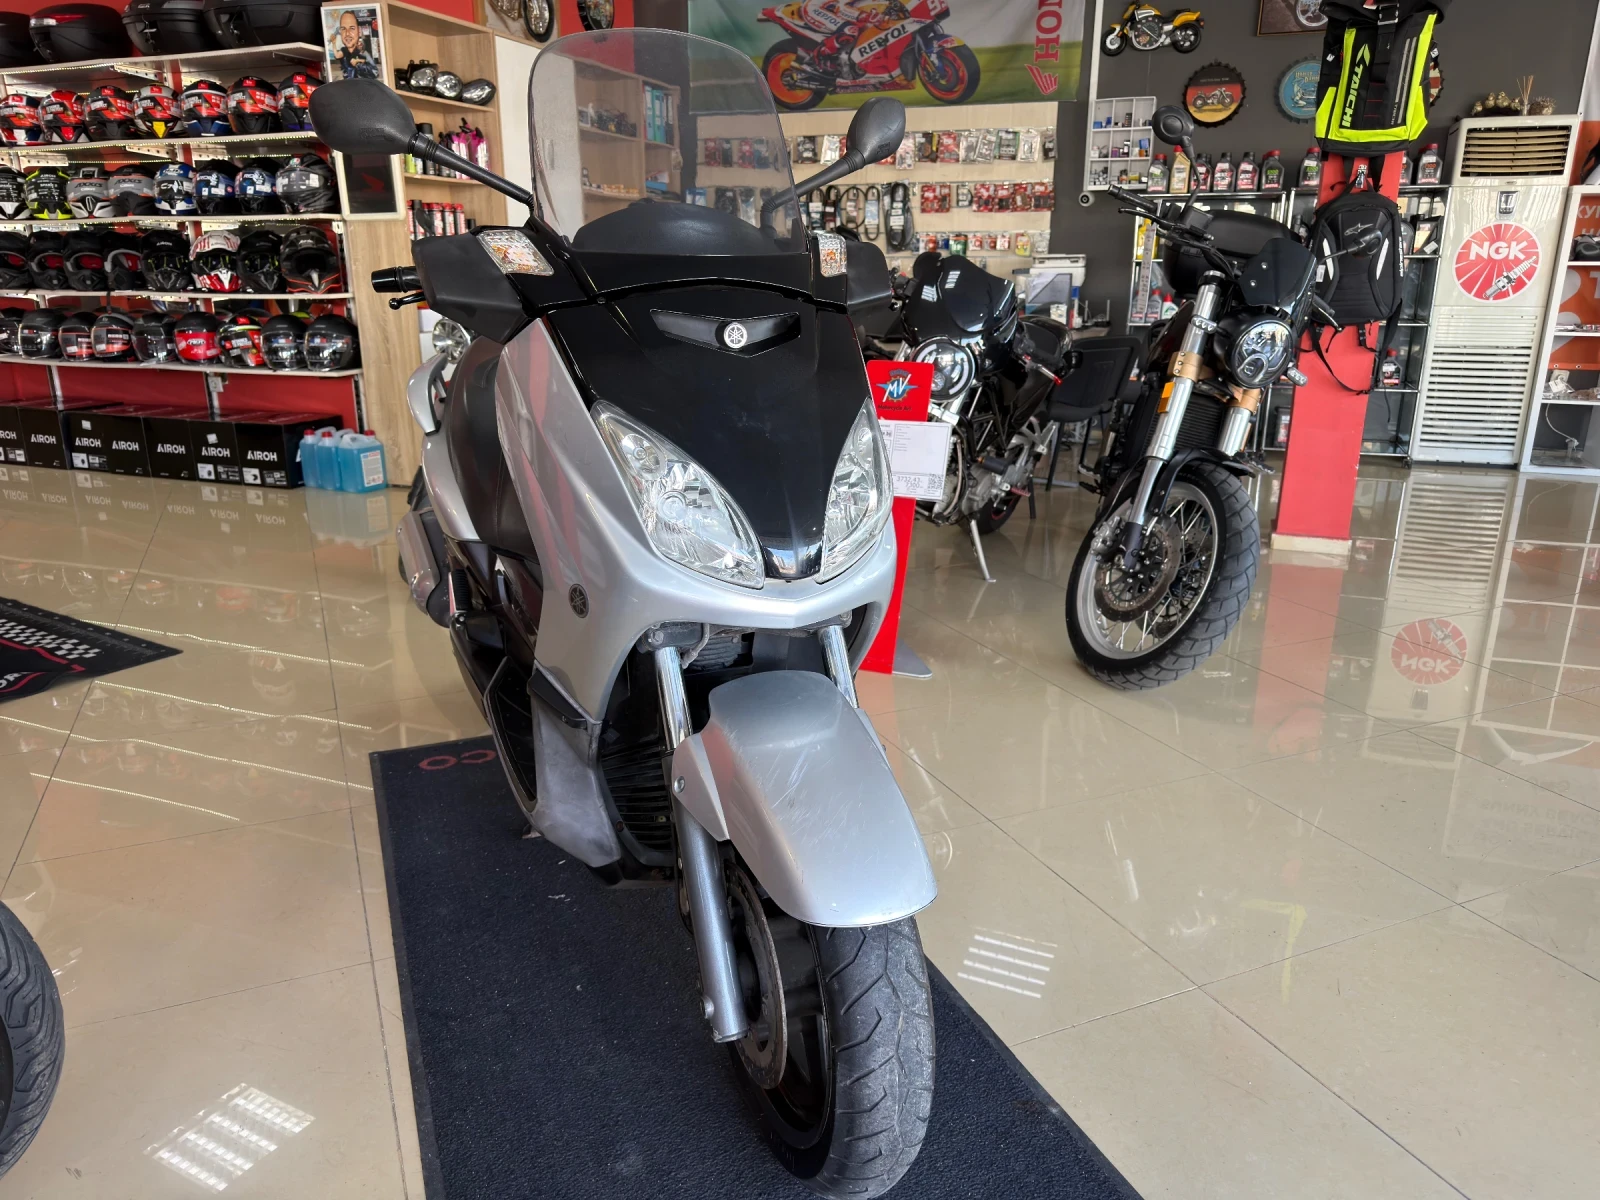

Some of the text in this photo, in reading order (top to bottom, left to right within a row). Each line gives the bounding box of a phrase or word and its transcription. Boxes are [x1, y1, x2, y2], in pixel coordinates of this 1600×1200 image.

[813, 8, 841, 27] REPSOL
[858, 23, 909, 58] REPSOL
[1341, 64, 1363, 127] TAICHI
[1469, 241, 1528, 261] NGK
[882, 373, 912, 403] MV
[0, 430, 17, 440] ROH
[31, 433, 57, 445] AIROH
[75, 437, 102, 448] AIROH
[112, 440, 140, 452] AIROH
[157, 443, 186, 455] AIROH
[202, 446, 231, 458] AIROH
[247, 450, 278, 462] AIROH
